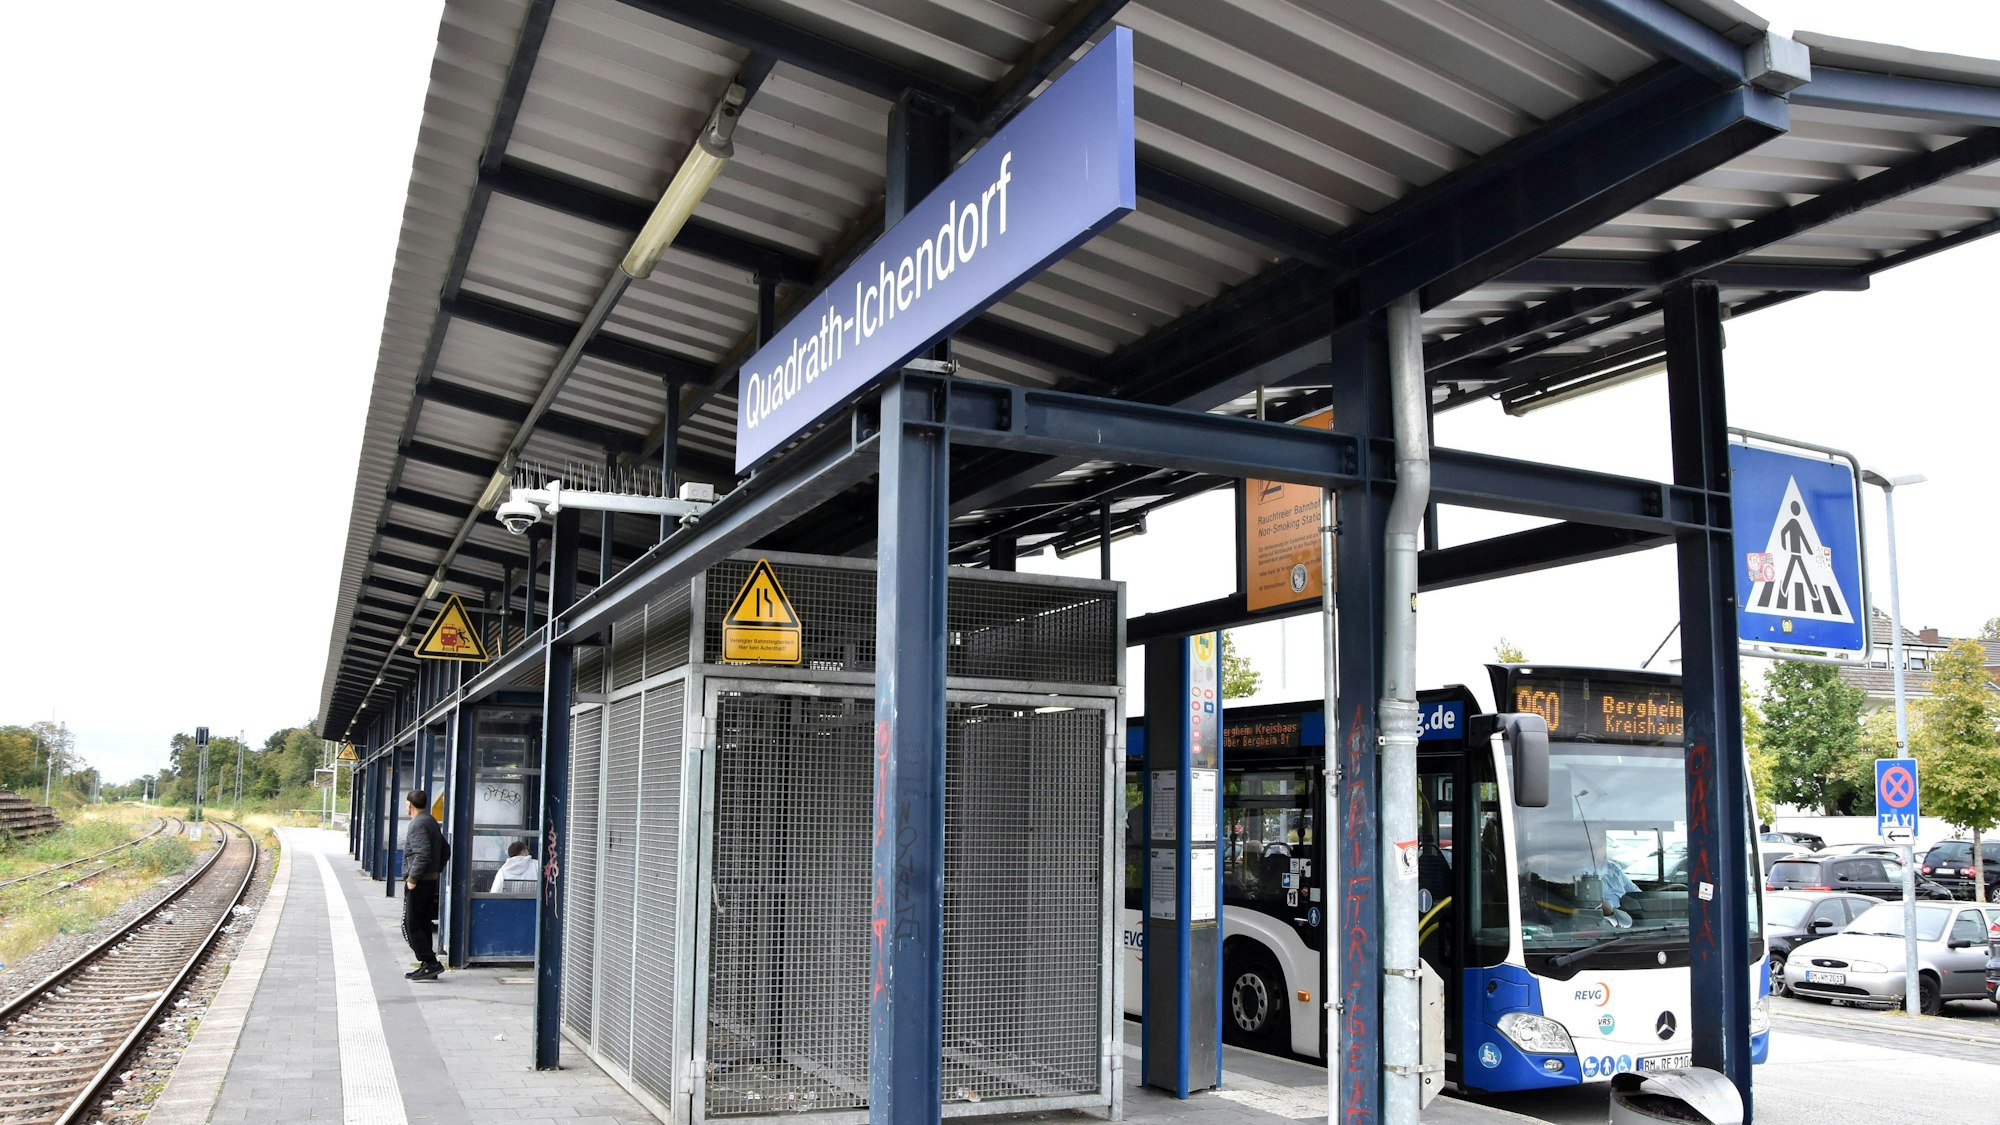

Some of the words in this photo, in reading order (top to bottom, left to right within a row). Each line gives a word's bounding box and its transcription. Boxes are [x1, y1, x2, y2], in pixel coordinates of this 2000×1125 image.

[746, 151, 1012, 430] Quadrath-Ichendorf
[1258, 508, 1292, 525] Rauchfreier
[1258, 519, 1300, 537] Non-Smoking
[1301, 512, 1321, 526] Statio
[1223, 725, 1253, 738] ergheim
[1255, 722, 1297, 735] Kreishaus
[1605, 714, 1684, 736] Kreishaus
[1243, 735, 1278, 748] Bergheim
[1881, 813, 1915, 829] TAXI
[1124, 930, 1143, 947] EVG
[1829, 974, 1843, 982] 2017
[1574, 989, 1602, 1001] REVG
[1597, 1018, 1611, 1026] VRS
